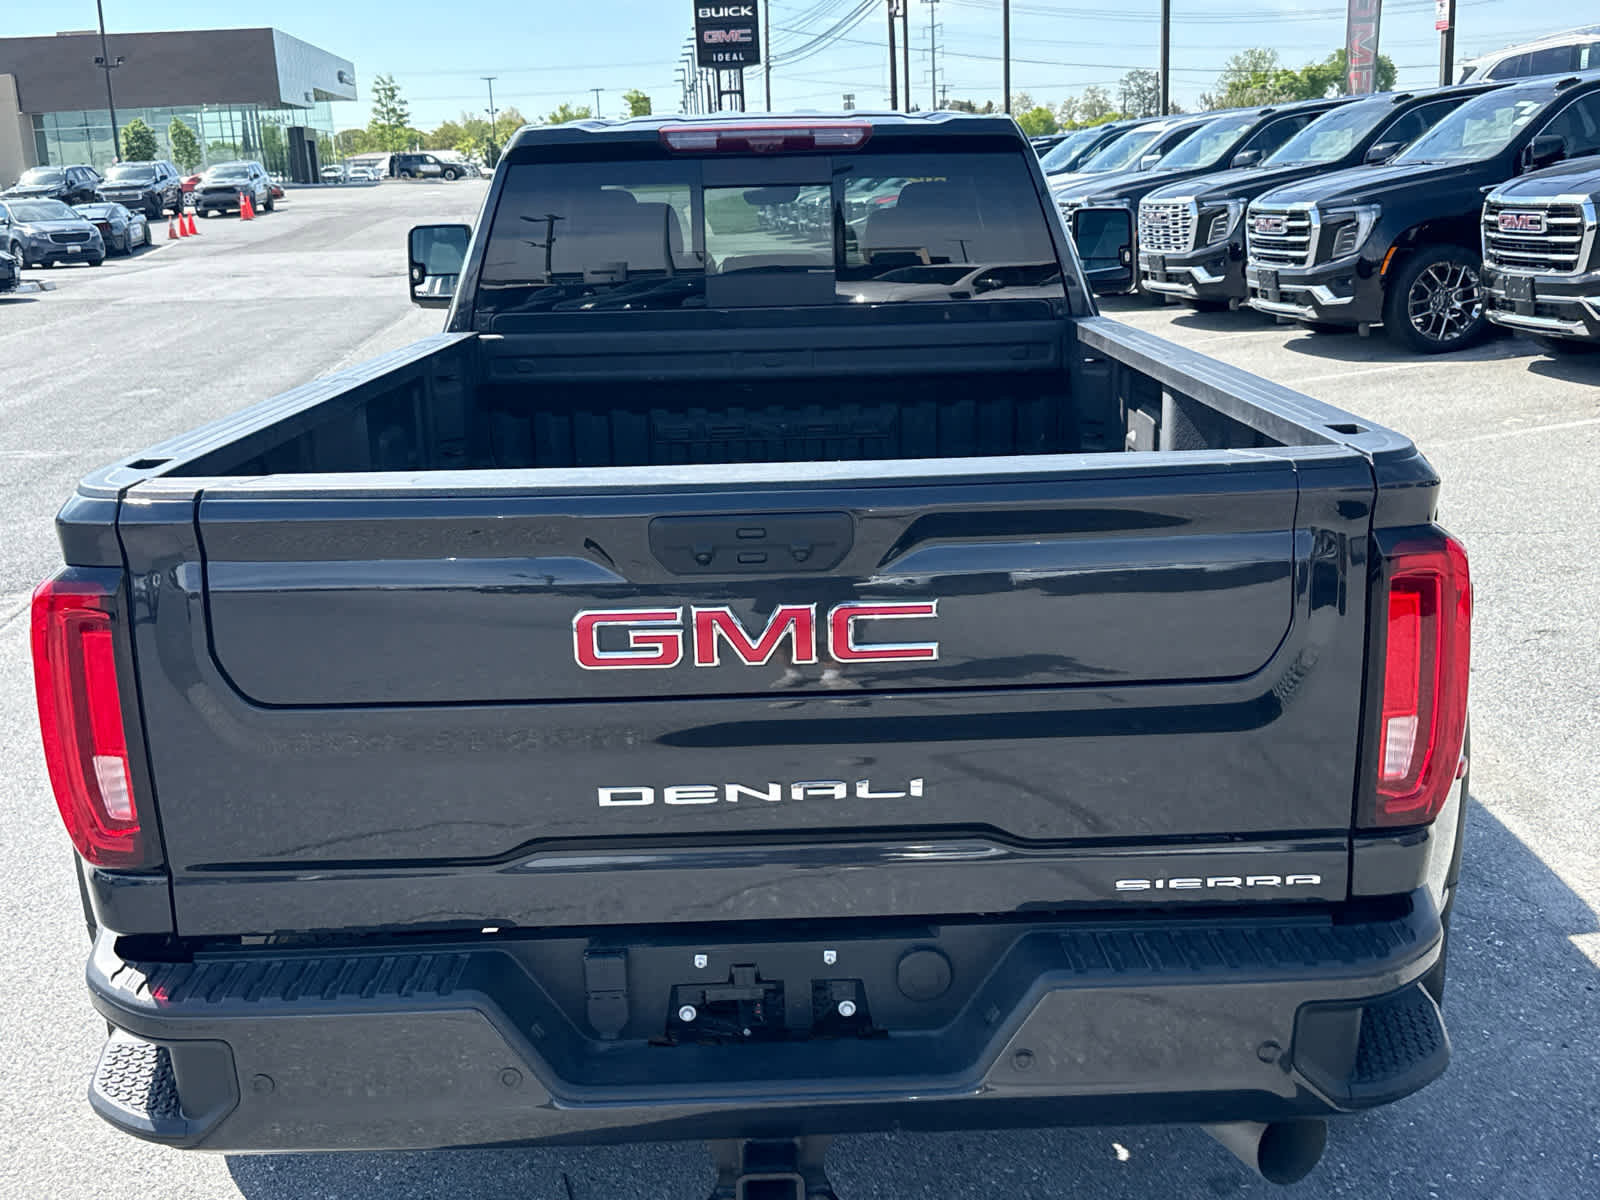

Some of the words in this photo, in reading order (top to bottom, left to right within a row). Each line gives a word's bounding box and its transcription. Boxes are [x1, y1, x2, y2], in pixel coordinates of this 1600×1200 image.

[698, 5, 753, 18] BUICK
[703, 29, 752, 43] GMC
[712, 52, 745, 62] IDEAL
[1499, 214, 1541, 230] GMC
[572, 599, 940, 671] GMC
[597, 778, 924, 807] DENALI
[1115, 874, 1321, 891] SIERRA
